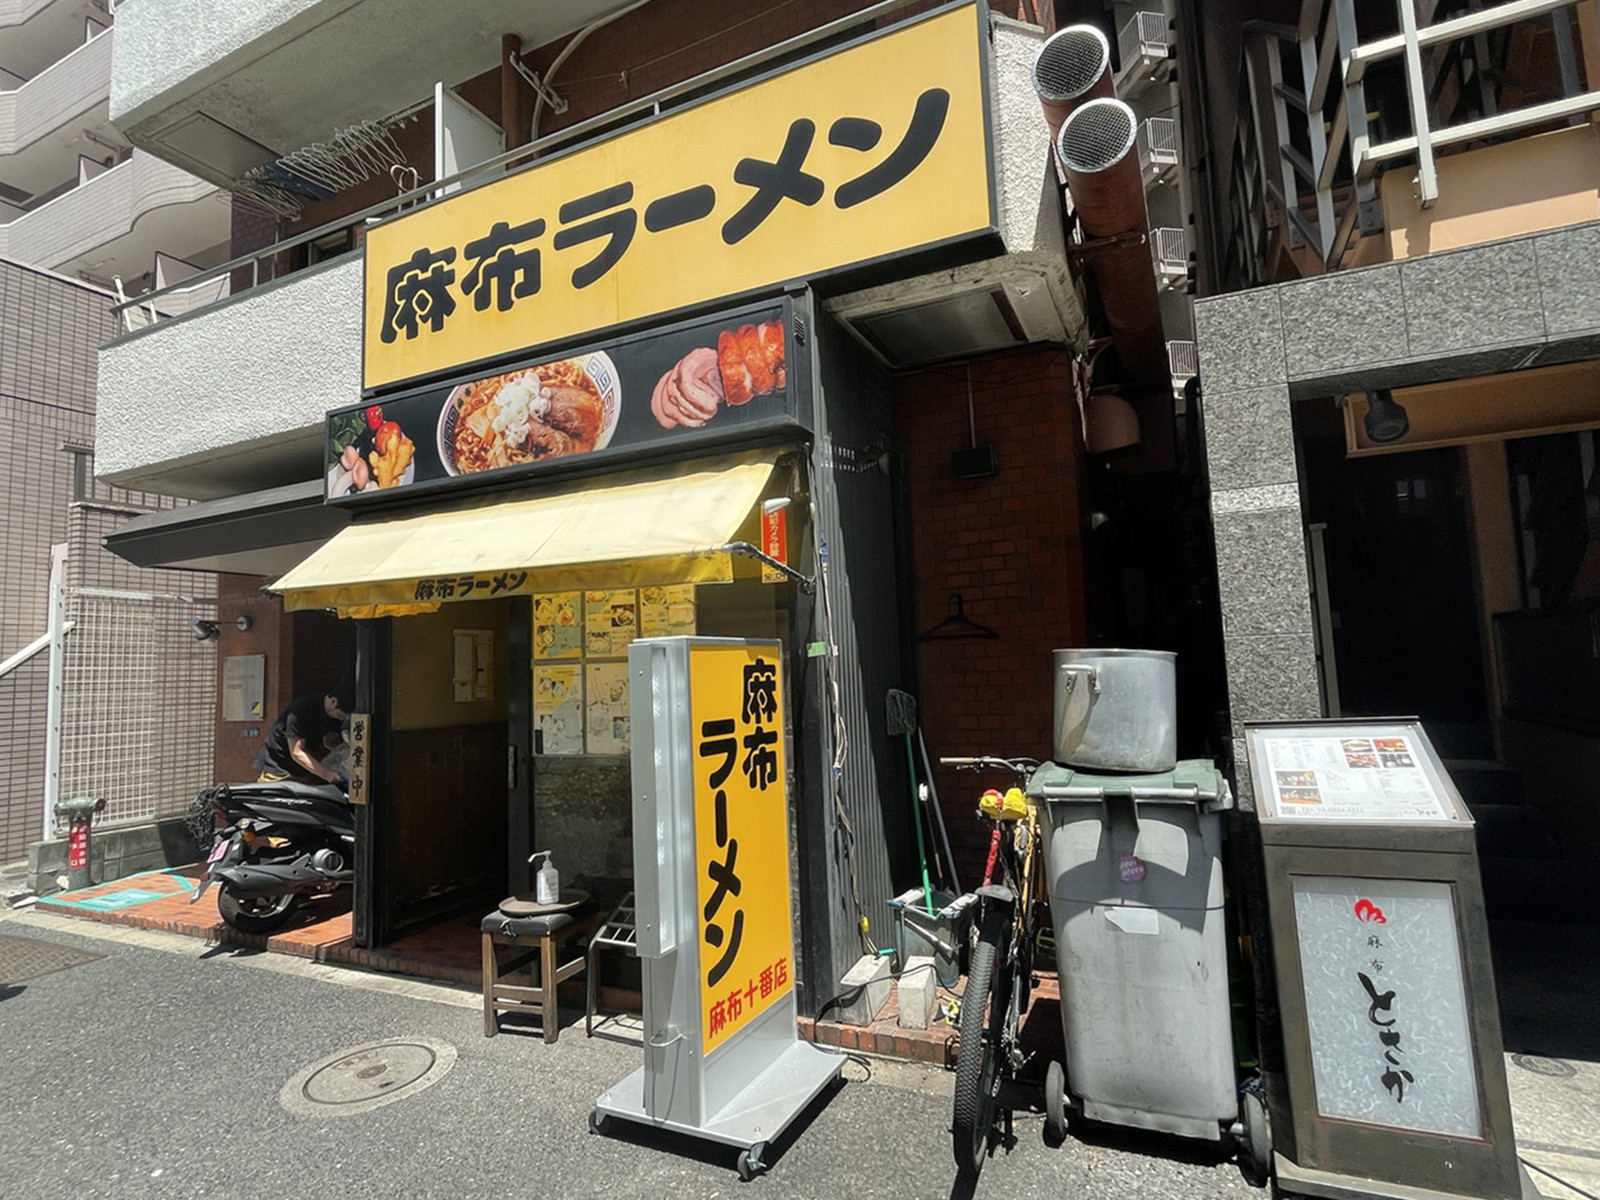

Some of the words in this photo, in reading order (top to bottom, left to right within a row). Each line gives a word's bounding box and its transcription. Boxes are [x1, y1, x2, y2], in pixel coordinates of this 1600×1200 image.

[379, 86, 951, 345] 麻布ラーメン
[414, 571, 529, 601] 麻布ラーメン
[351, 719, 366, 798] 営業中
[741, 657, 779, 792] 麻布
[699, 717, 744, 989] ラーメン
[708, 956, 787, 1040] 麻布十番店
